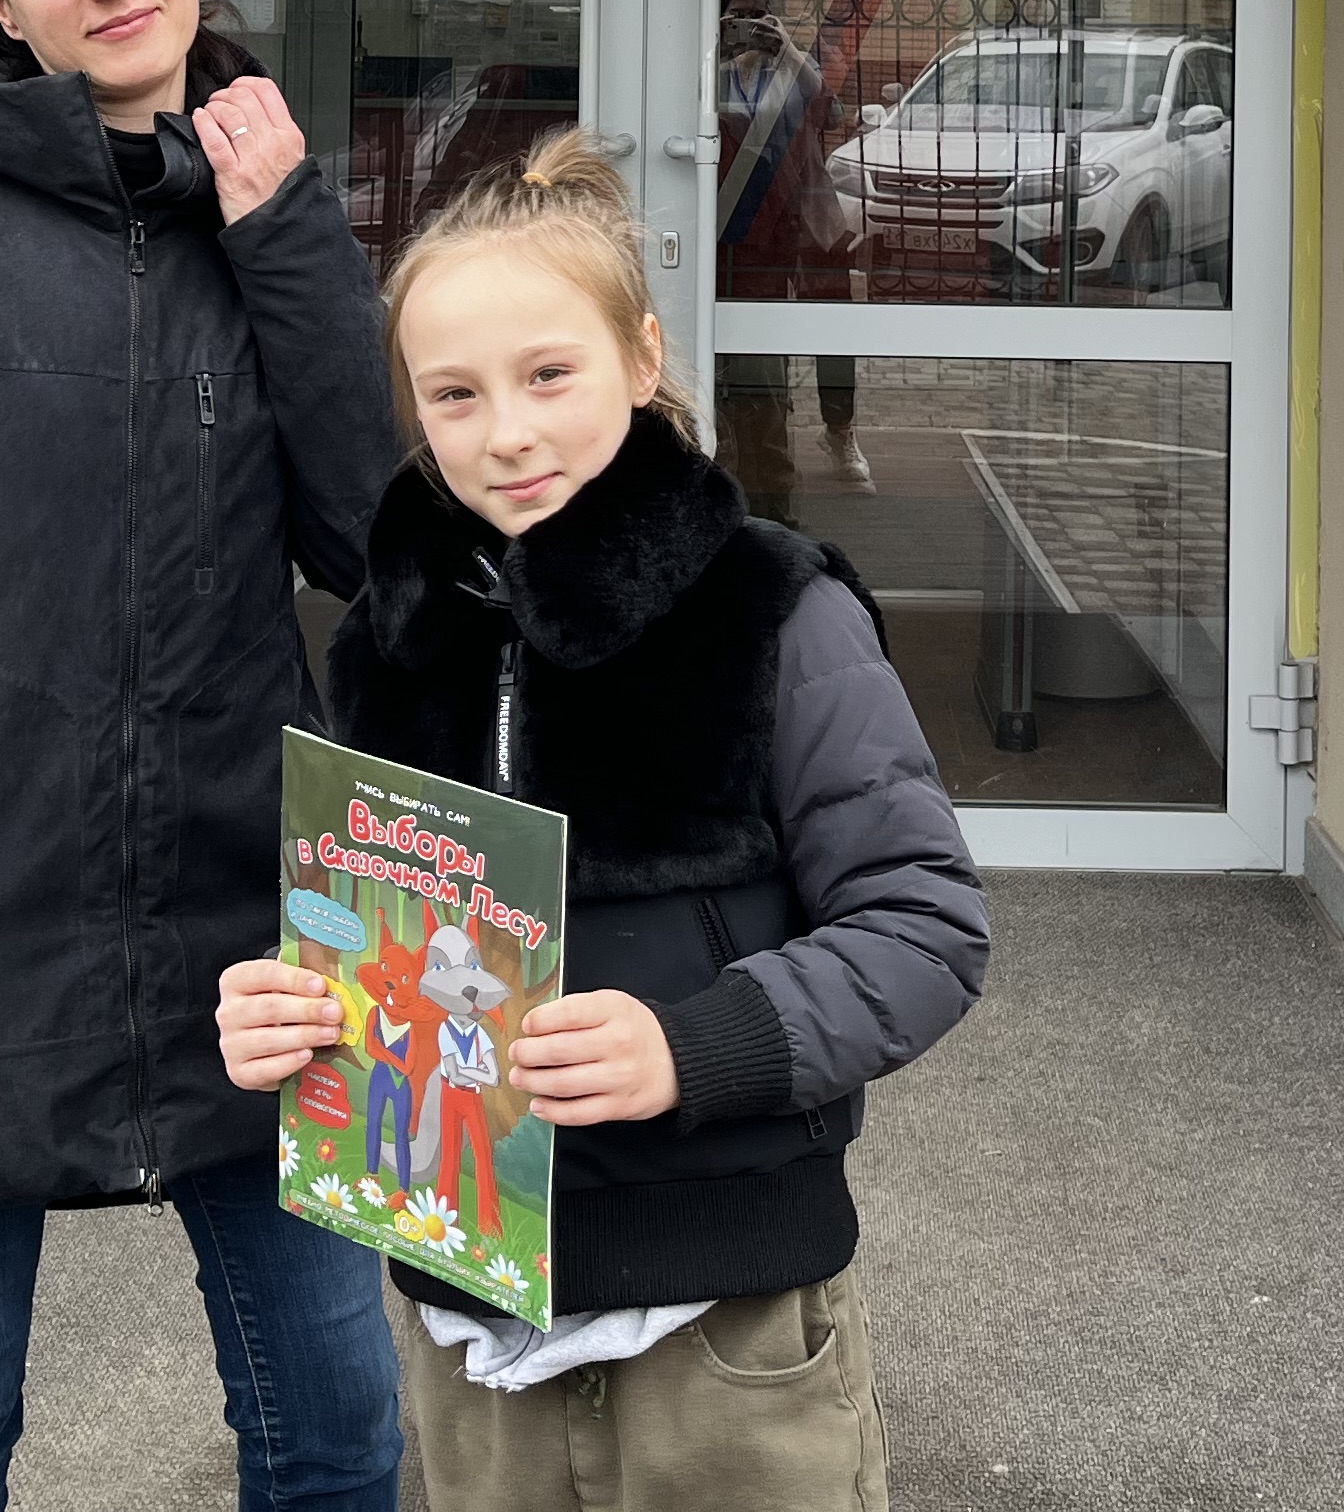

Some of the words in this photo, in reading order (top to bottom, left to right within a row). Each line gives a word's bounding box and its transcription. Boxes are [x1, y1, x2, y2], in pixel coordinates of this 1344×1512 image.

[355, 780, 385, 799] УЧИСЬ
[389, 792, 441, 817] ВЫБИРАТЬ
[446, 810, 471, 827] САМ!
[347, 798, 485, 880] Выборы
[317, 833, 461, 907] Сказочном
[467, 883, 548, 951] Лесу
[399, 1216, 419, 1233] 0+
